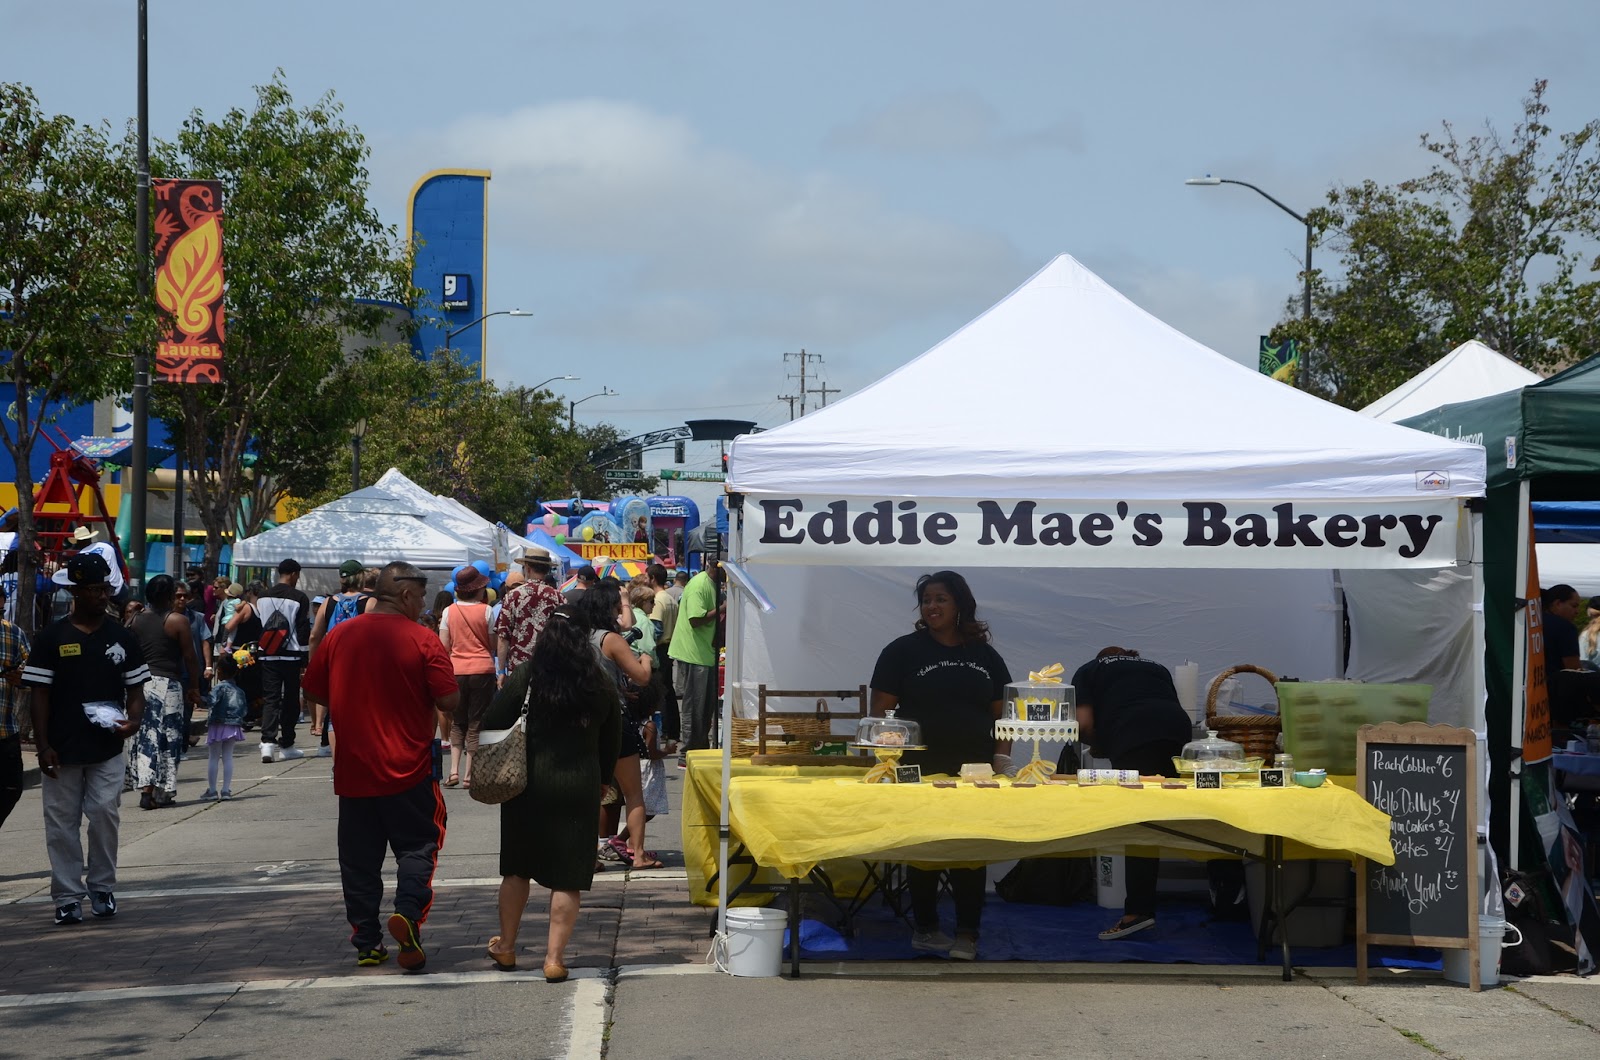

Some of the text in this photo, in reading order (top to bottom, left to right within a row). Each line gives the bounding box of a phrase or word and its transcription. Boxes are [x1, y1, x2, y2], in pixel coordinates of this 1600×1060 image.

[650, 506, 685, 516] FROZEN
[759, 499, 1443, 559] Eddie Mae's Bakery
[583, 544, 646, 558] TICKETS
[1372, 750, 1453, 778] Peach Cobbler $6
[1372, 780, 1398, 815] Hello
[1441, 789, 1460, 822] $4
[1406, 819, 1435, 834] Cookies
[1438, 819, 1455, 835] $2
[1435, 836, 1455, 868] $4
[1371, 868, 1442, 915] Thank You!
